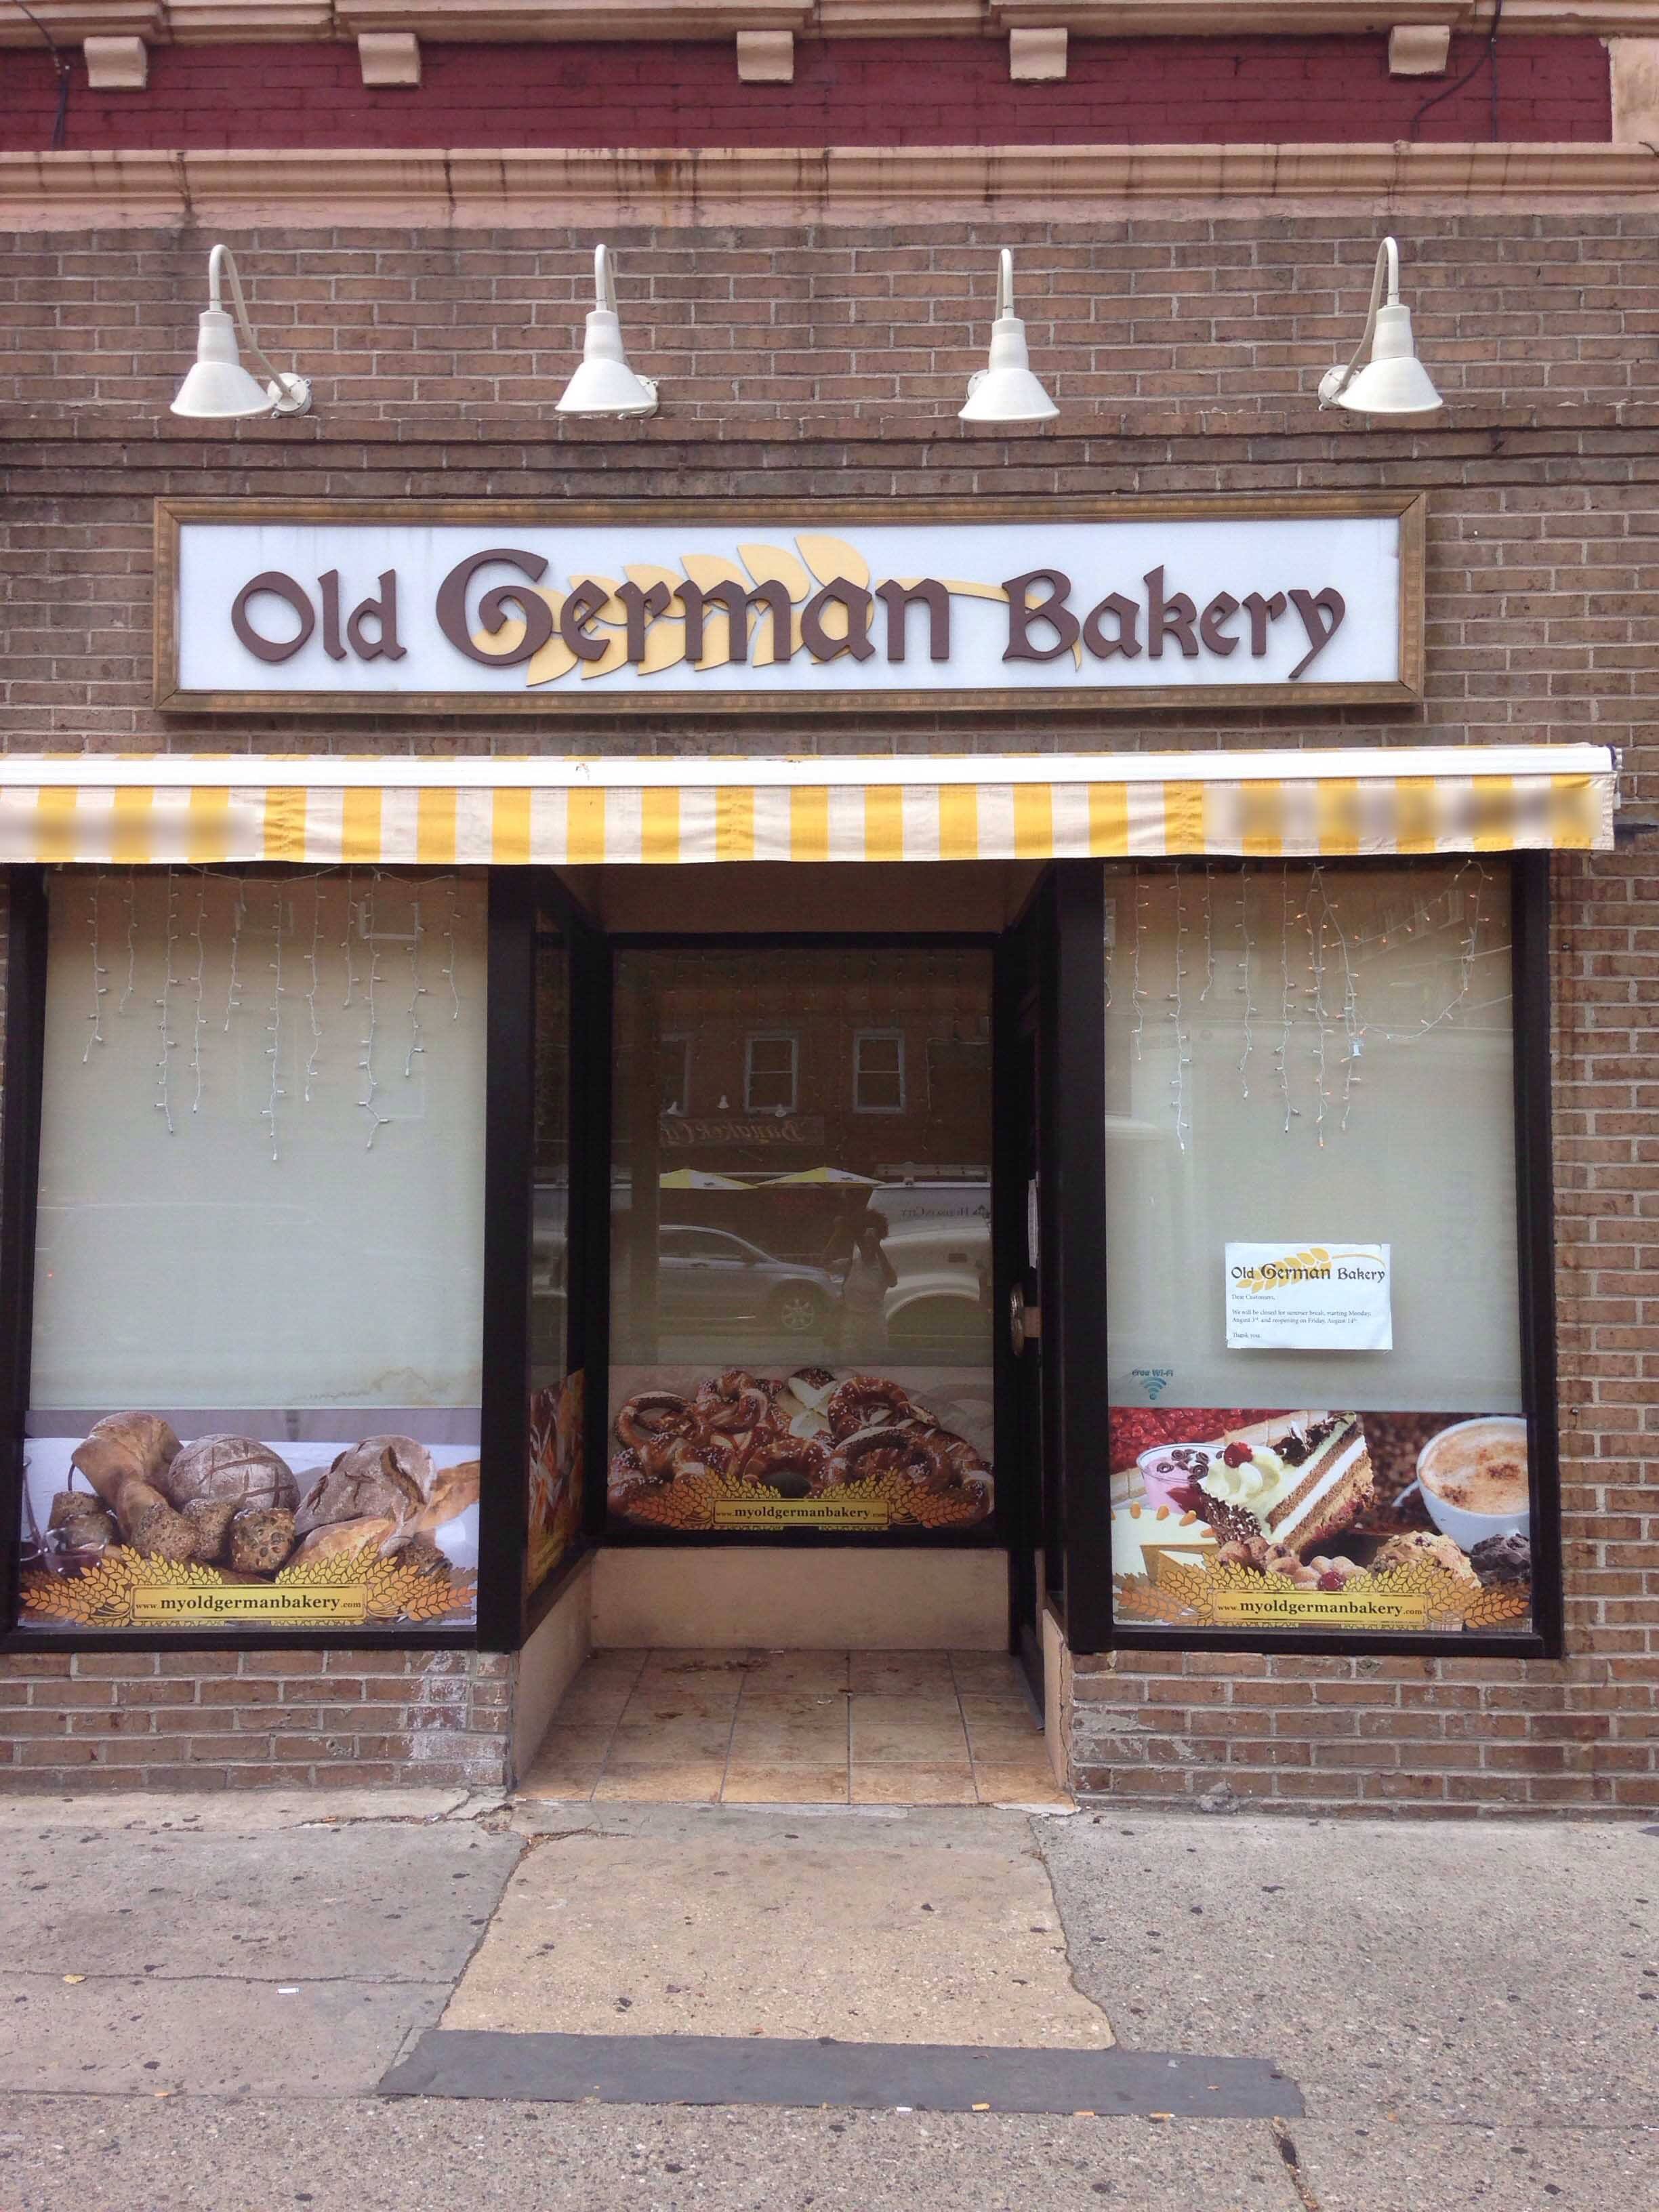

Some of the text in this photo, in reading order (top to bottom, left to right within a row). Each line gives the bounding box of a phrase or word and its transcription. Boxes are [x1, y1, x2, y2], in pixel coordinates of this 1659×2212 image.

[230, 548, 1346, 679] Old German Bakery
[1231, 1263, 1385, 1284] Old German Bakery
